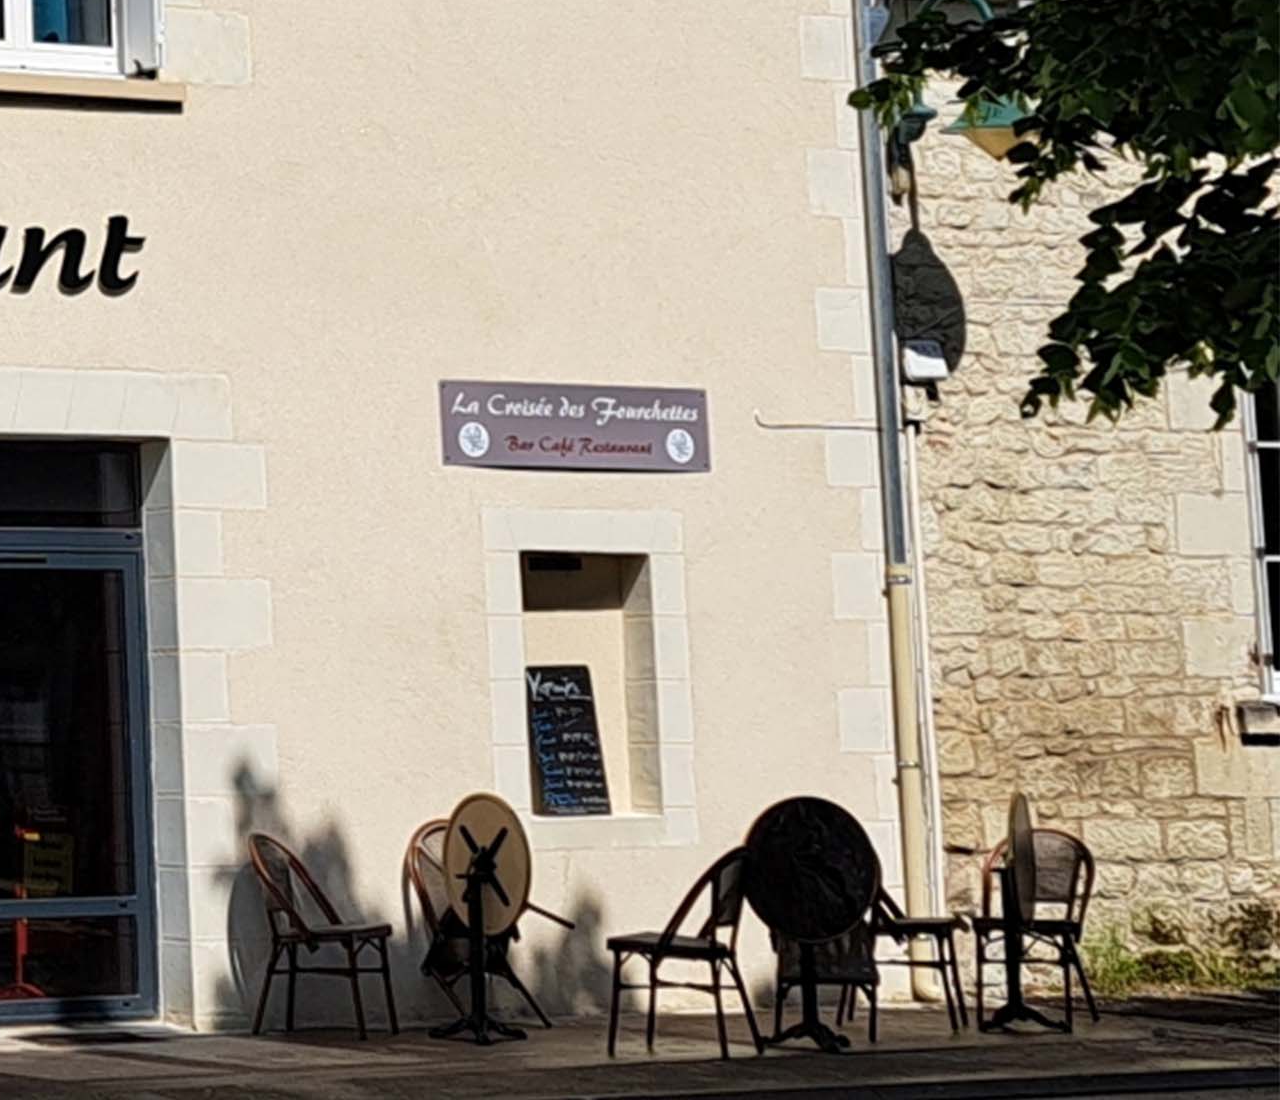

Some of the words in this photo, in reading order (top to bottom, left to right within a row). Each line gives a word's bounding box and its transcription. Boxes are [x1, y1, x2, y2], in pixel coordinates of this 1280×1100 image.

[451, 391, 480, 415] La
[559, 395, 585, 418] des
[504, 435, 534, 452] Bar
